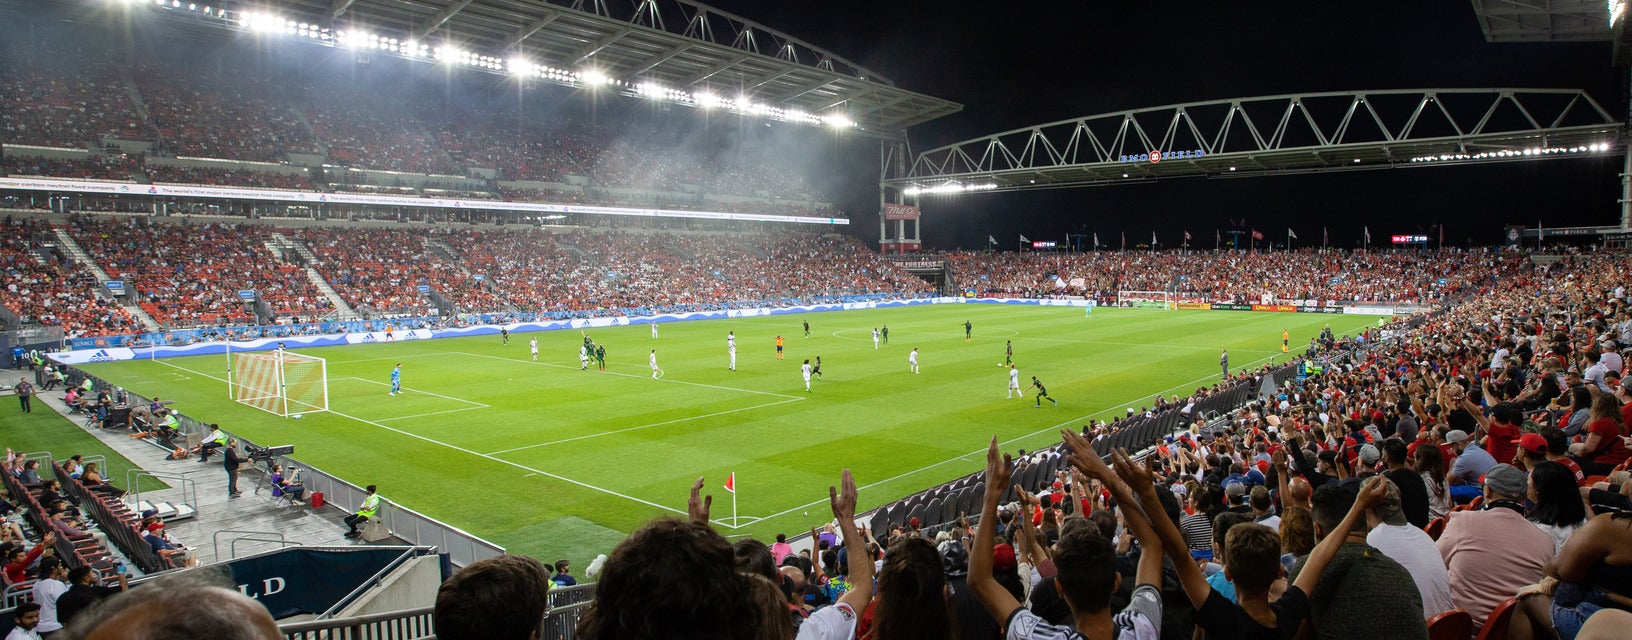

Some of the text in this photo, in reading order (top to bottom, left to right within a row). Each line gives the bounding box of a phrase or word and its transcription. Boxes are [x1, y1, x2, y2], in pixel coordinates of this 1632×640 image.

[1120, 149, 1203, 163] BMO FIELD
[888, 206, 905, 215] Mill
